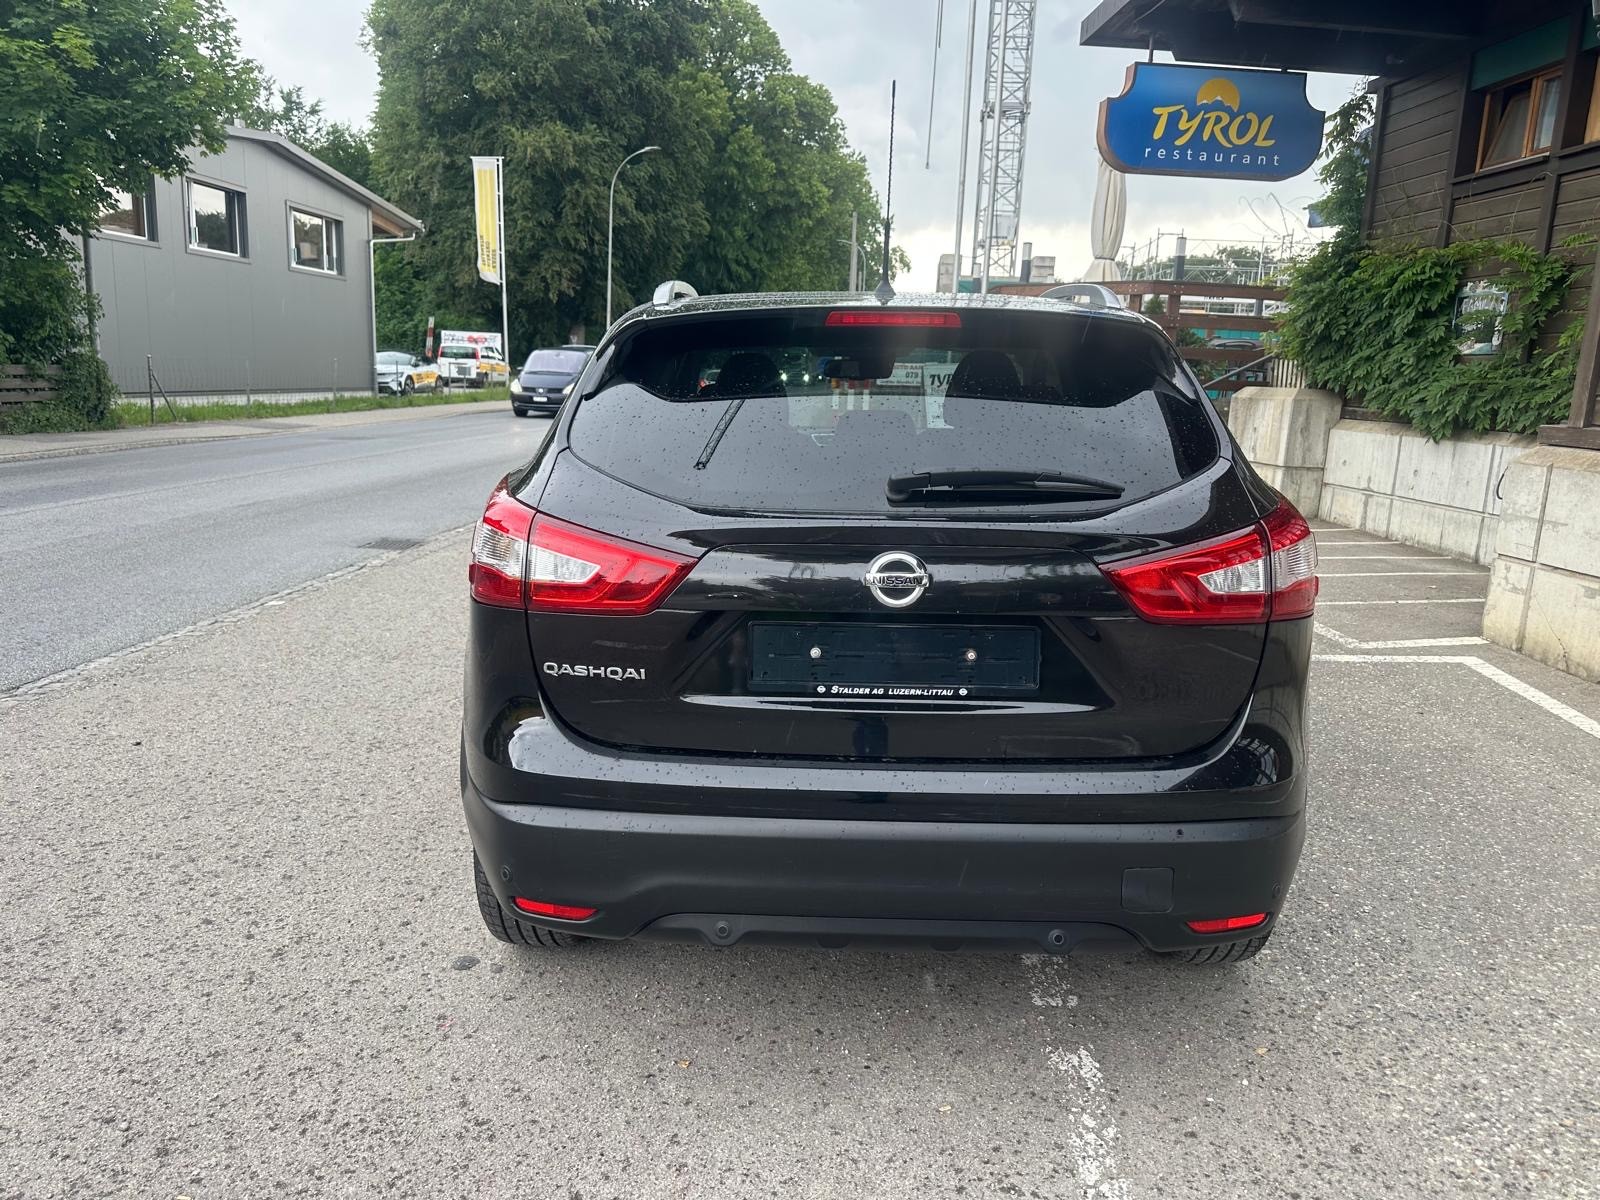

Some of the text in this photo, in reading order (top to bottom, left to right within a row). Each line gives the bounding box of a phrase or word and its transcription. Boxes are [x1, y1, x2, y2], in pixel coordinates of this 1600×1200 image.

[1152, 104, 1275, 148] TYROL
[1144, 146, 1280, 166] restaurant
[872, 575, 923, 585] NISSAN
[543, 662, 646, 681] QASHQAI
[831, 685, 870, 695] STALDER
[888, 688, 954, 696] LUZERN-LITTAU
